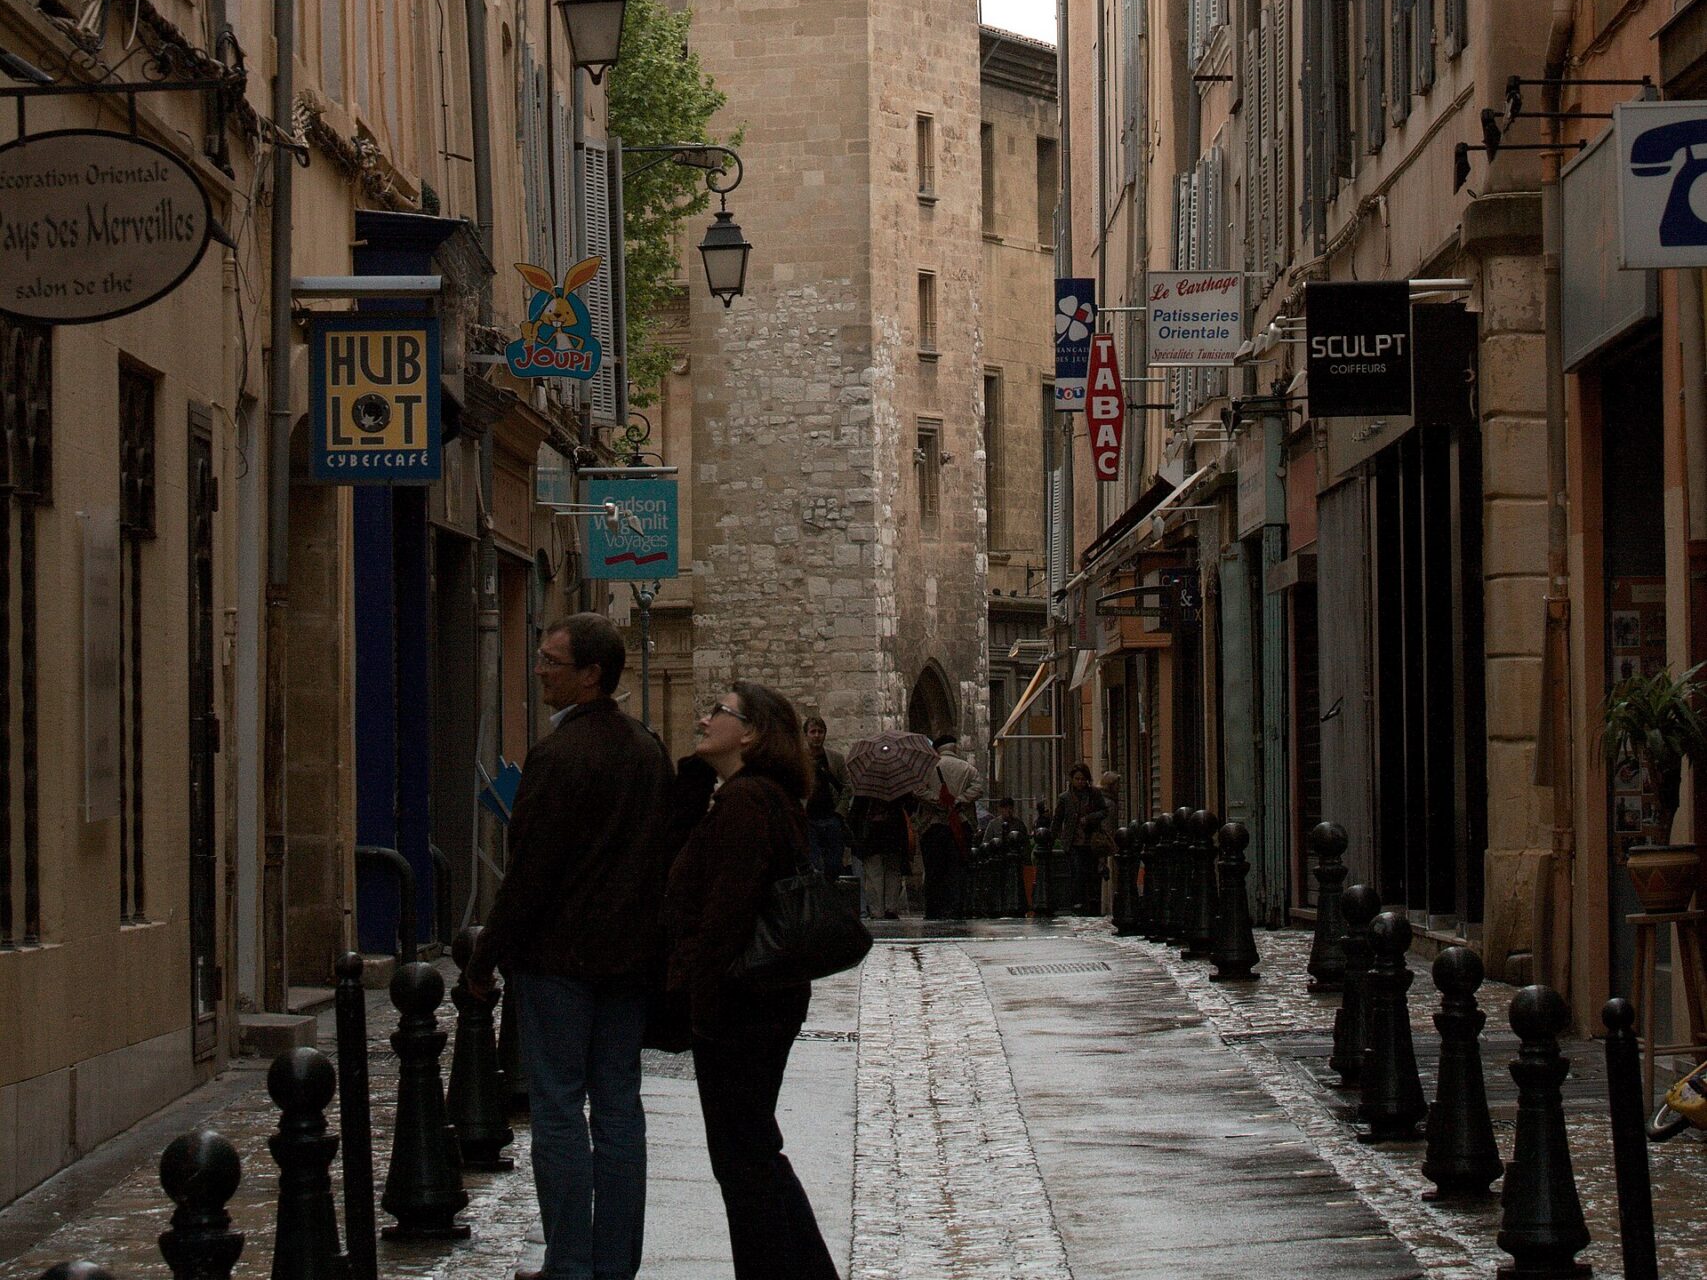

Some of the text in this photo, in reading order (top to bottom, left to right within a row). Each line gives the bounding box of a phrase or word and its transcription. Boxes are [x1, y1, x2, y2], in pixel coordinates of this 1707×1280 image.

[86, 161, 168, 186] Orientale
[0, 197, 194, 261] ays des Merveilles
[15, 271, 133, 300] salon de thé
[1150, 276, 1239, 301] Le Carthage
[1153, 308, 1239, 322] Patisseries
[1158, 326, 1230, 339] Orientale
[1311, 333, 1406, 359] SCULPT
[330, 335, 422, 386] HUB
[1072, 355, 1089, 363] JEU
[1329, 363, 1387, 375] COIFFEURS
[1056, 387, 1085, 400] LOT
[1092, 339, 1120, 475] TABAC
[326, 451, 429, 467] CYBERCAFÉ
[593, 513, 669, 535] Wgnlit
[604, 531, 668, 553] Voyages
